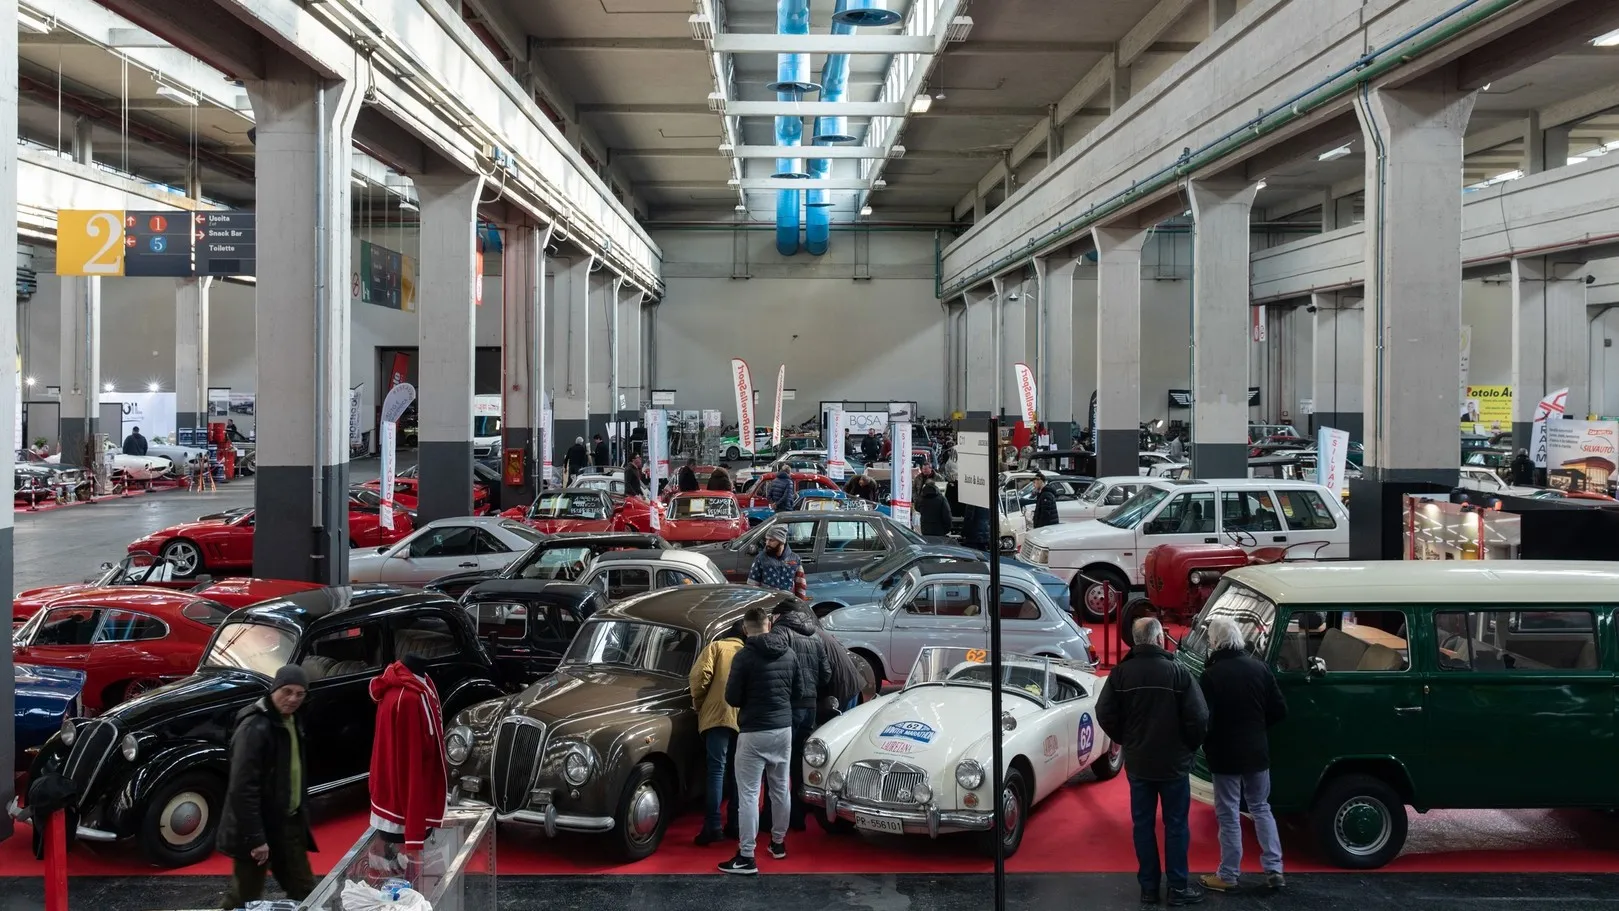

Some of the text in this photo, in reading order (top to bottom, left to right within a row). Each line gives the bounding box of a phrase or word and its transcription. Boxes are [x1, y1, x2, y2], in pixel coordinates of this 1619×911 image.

[82, 212, 121, 273] 2
[154, 237, 163, 251] 5
[209, 244, 236, 252] Toilette
[849, 415, 882, 427] BOSA
[1583, 444, 1612, 454] SILVAUTO
[966, 649, 987, 663] 62
[884, 726, 905, 735] WINTER
[903, 729, 935, 740] MARATHON
[1080, 725, 1092, 750] 62
